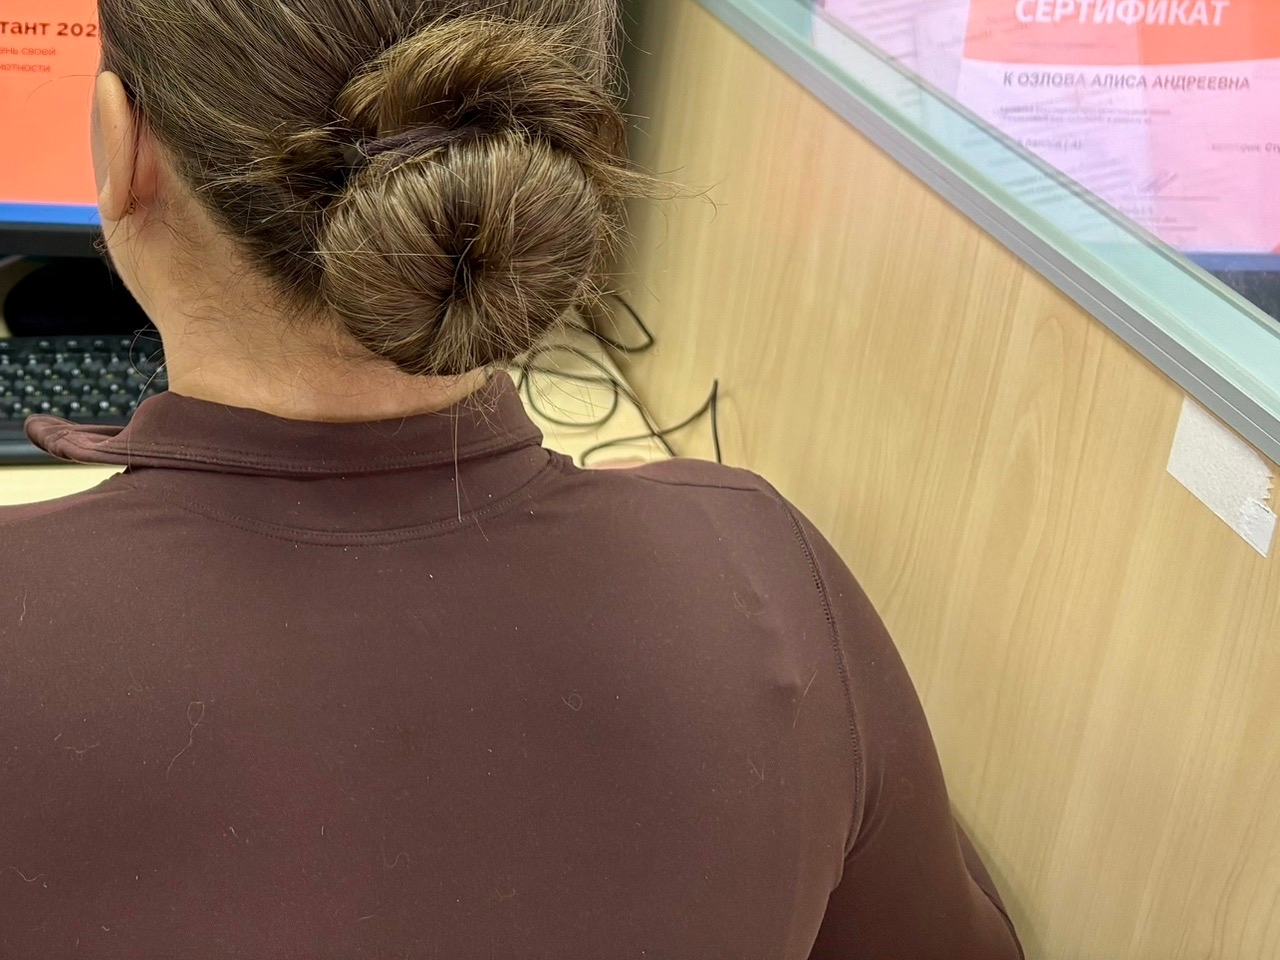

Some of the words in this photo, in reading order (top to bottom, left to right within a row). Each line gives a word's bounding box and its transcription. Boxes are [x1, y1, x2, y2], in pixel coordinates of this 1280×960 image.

[56, 22, 97, 38] 202
[21, 46, 56, 56] своей
[1090, 73, 1147, 89] АЛИСА
[1151, 75, 1250, 92] АНДРЕЕВНА
